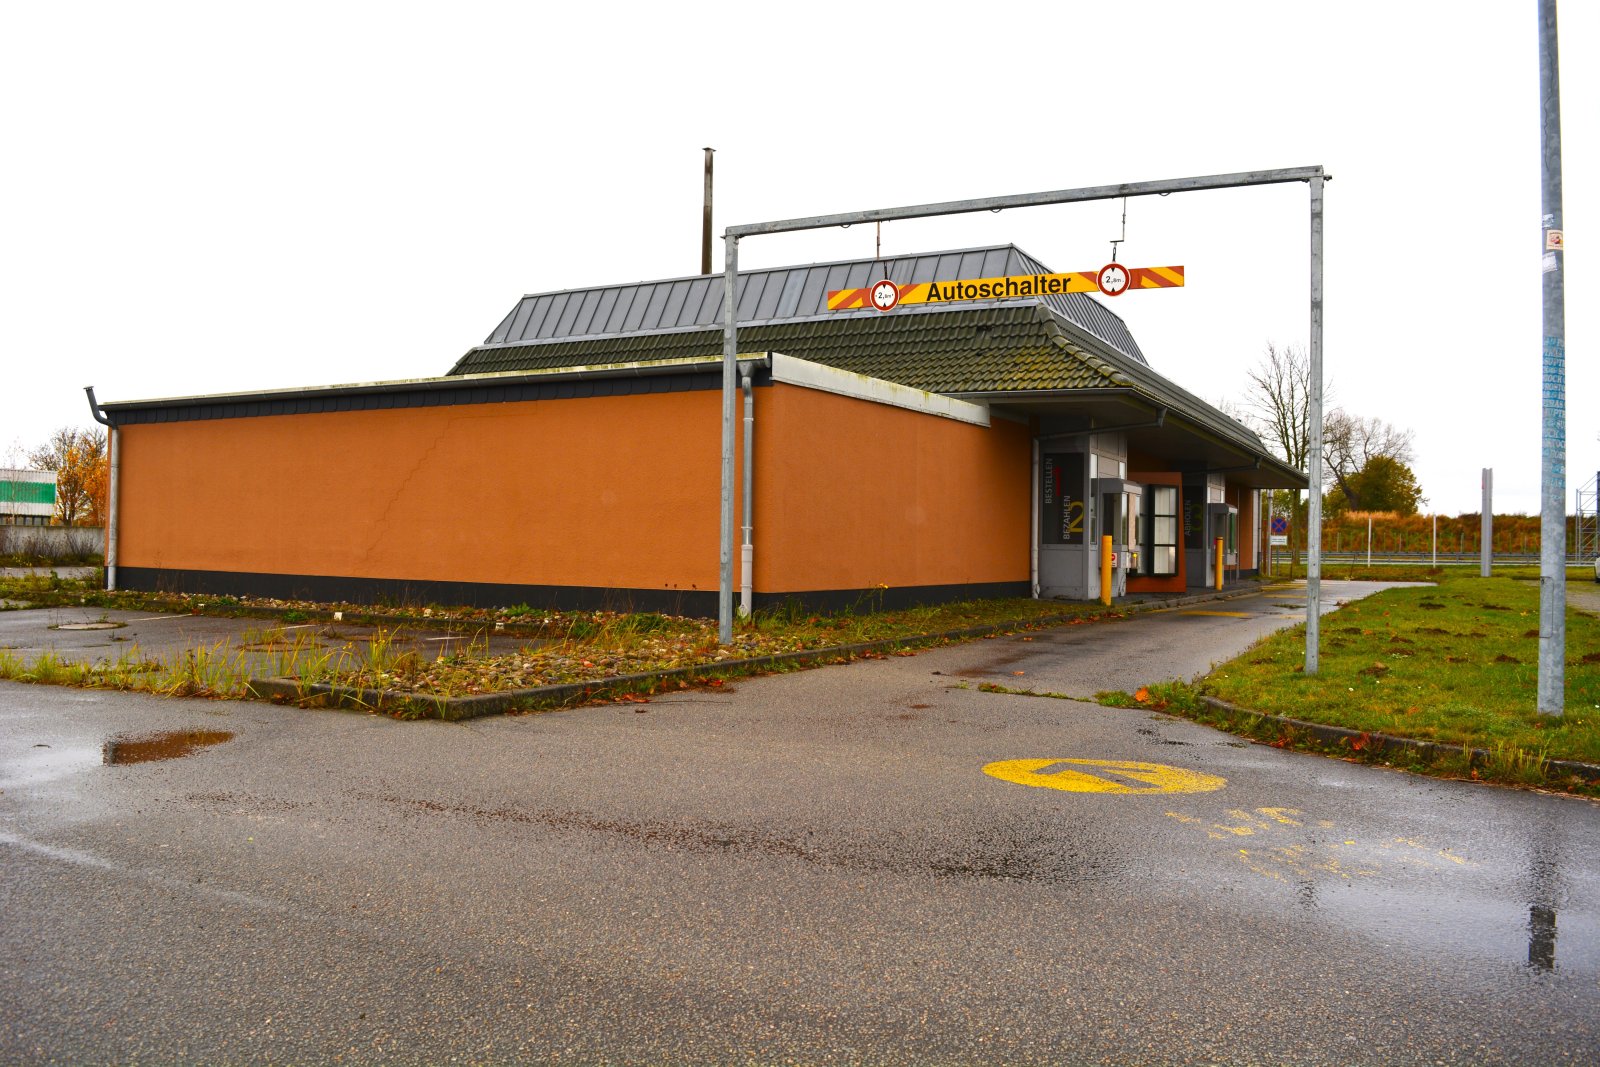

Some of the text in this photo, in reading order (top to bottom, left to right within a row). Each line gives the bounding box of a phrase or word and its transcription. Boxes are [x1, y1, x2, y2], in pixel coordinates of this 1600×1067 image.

[926, 275, 1071, 301] Autoschalter
[1045, 458, 1053, 504] BESTELLEN
[1063, 495, 1071, 540] BEZAHLEN
[1068, 501, 1085, 533] 2
